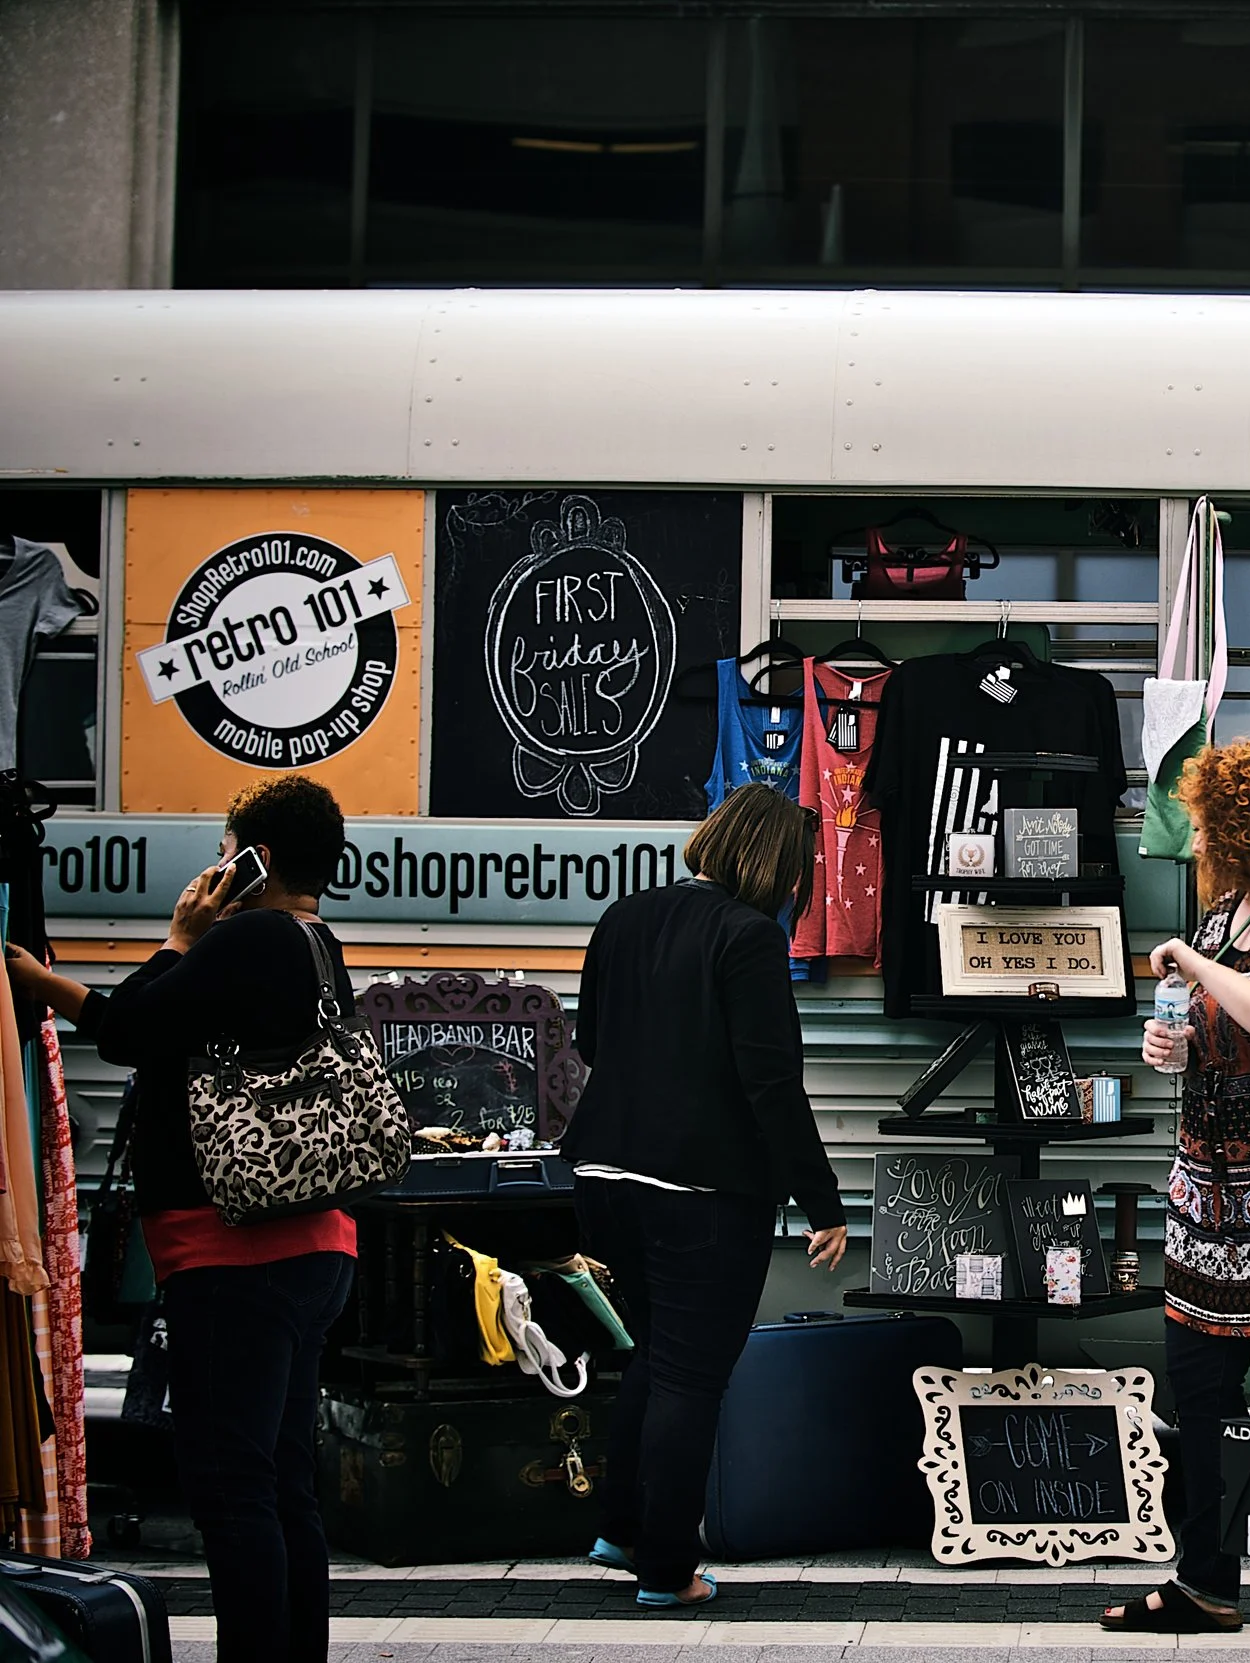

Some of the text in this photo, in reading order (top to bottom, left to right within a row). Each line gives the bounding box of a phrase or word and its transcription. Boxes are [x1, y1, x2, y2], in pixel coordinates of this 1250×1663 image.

[177, 540, 337, 628] ShopRetro101.com
[535, 571, 624, 624] FIRST
[183, 579, 363, 681] retro 101
[222, 633, 356, 699] Rollin' Old School
[511, 633, 650, 717] friday
[213, 660, 393, 765] mobile pop-up shop
[540, 671, 623, 737] SALES
[833, 774, 863, 788] INDIAN
[1019, 861, 1036, 877] for
[1024, 840, 1063, 856] GOT TIME
[323, 837, 675, 914] @shopretro101
[977, 932, 1086, 945] I LOVE YOU
[969, 957, 1097, 970] OH YES I DO.
[383, 1023, 535, 1066] HEADBAND BAR
[392, 1069, 425, 1093] $15
[450, 1110, 470, 1133] 2
[507, 1104, 536, 1129] $25
[887, 1158, 955, 1207] Love
[892, 1256, 958, 1294] Bac
[1005, 1412, 1080, 1470] COME
[979, 1478, 1115, 1519] ON INSIDE
